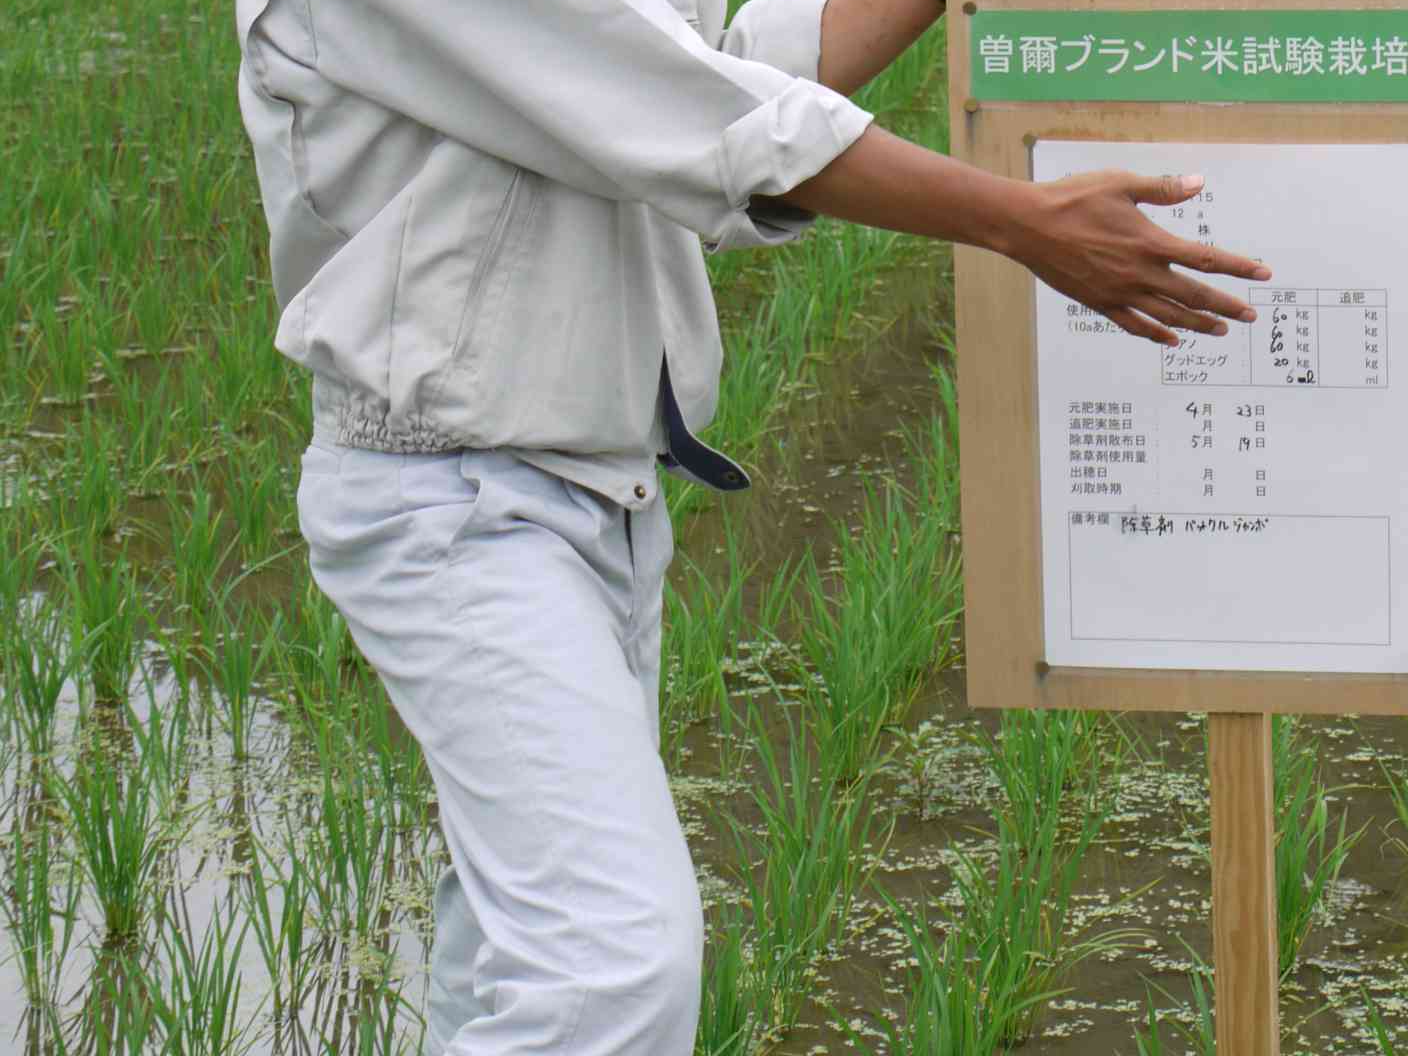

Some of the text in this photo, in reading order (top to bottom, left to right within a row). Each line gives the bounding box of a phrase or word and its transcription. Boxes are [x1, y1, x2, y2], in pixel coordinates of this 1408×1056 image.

[1172, 208, 1184, 219] 12
[1272, 291, 1296, 304] 元肥
[1296, 309, 1310, 321] kg
[1365, 310, 1378, 321] kg
[1296, 325, 1309, 337] kg
[1365, 326, 1378, 337] kg
[1296, 341, 1310, 353] kg
[1365, 342, 1379, 353] kg
[1274, 358, 1289, 367] 20
[1297, 357, 1310, 369] kg
[1366, 358, 1379, 369] kg
[1366, 375, 1379, 385] ml
[1069, 402, 1132, 414] 元肥実施日
[1069, 418, 1265, 432] 追肥実施日 月 日
[1069, 434, 1146, 447] 除草剤散布日
[1070, 450, 1146, 463] 除草剤使用量
[1203, 469, 1213, 480] 月
[1256, 470, 1265, 481] 日
[1072, 482, 1266, 496] 刈取時期 月 日
